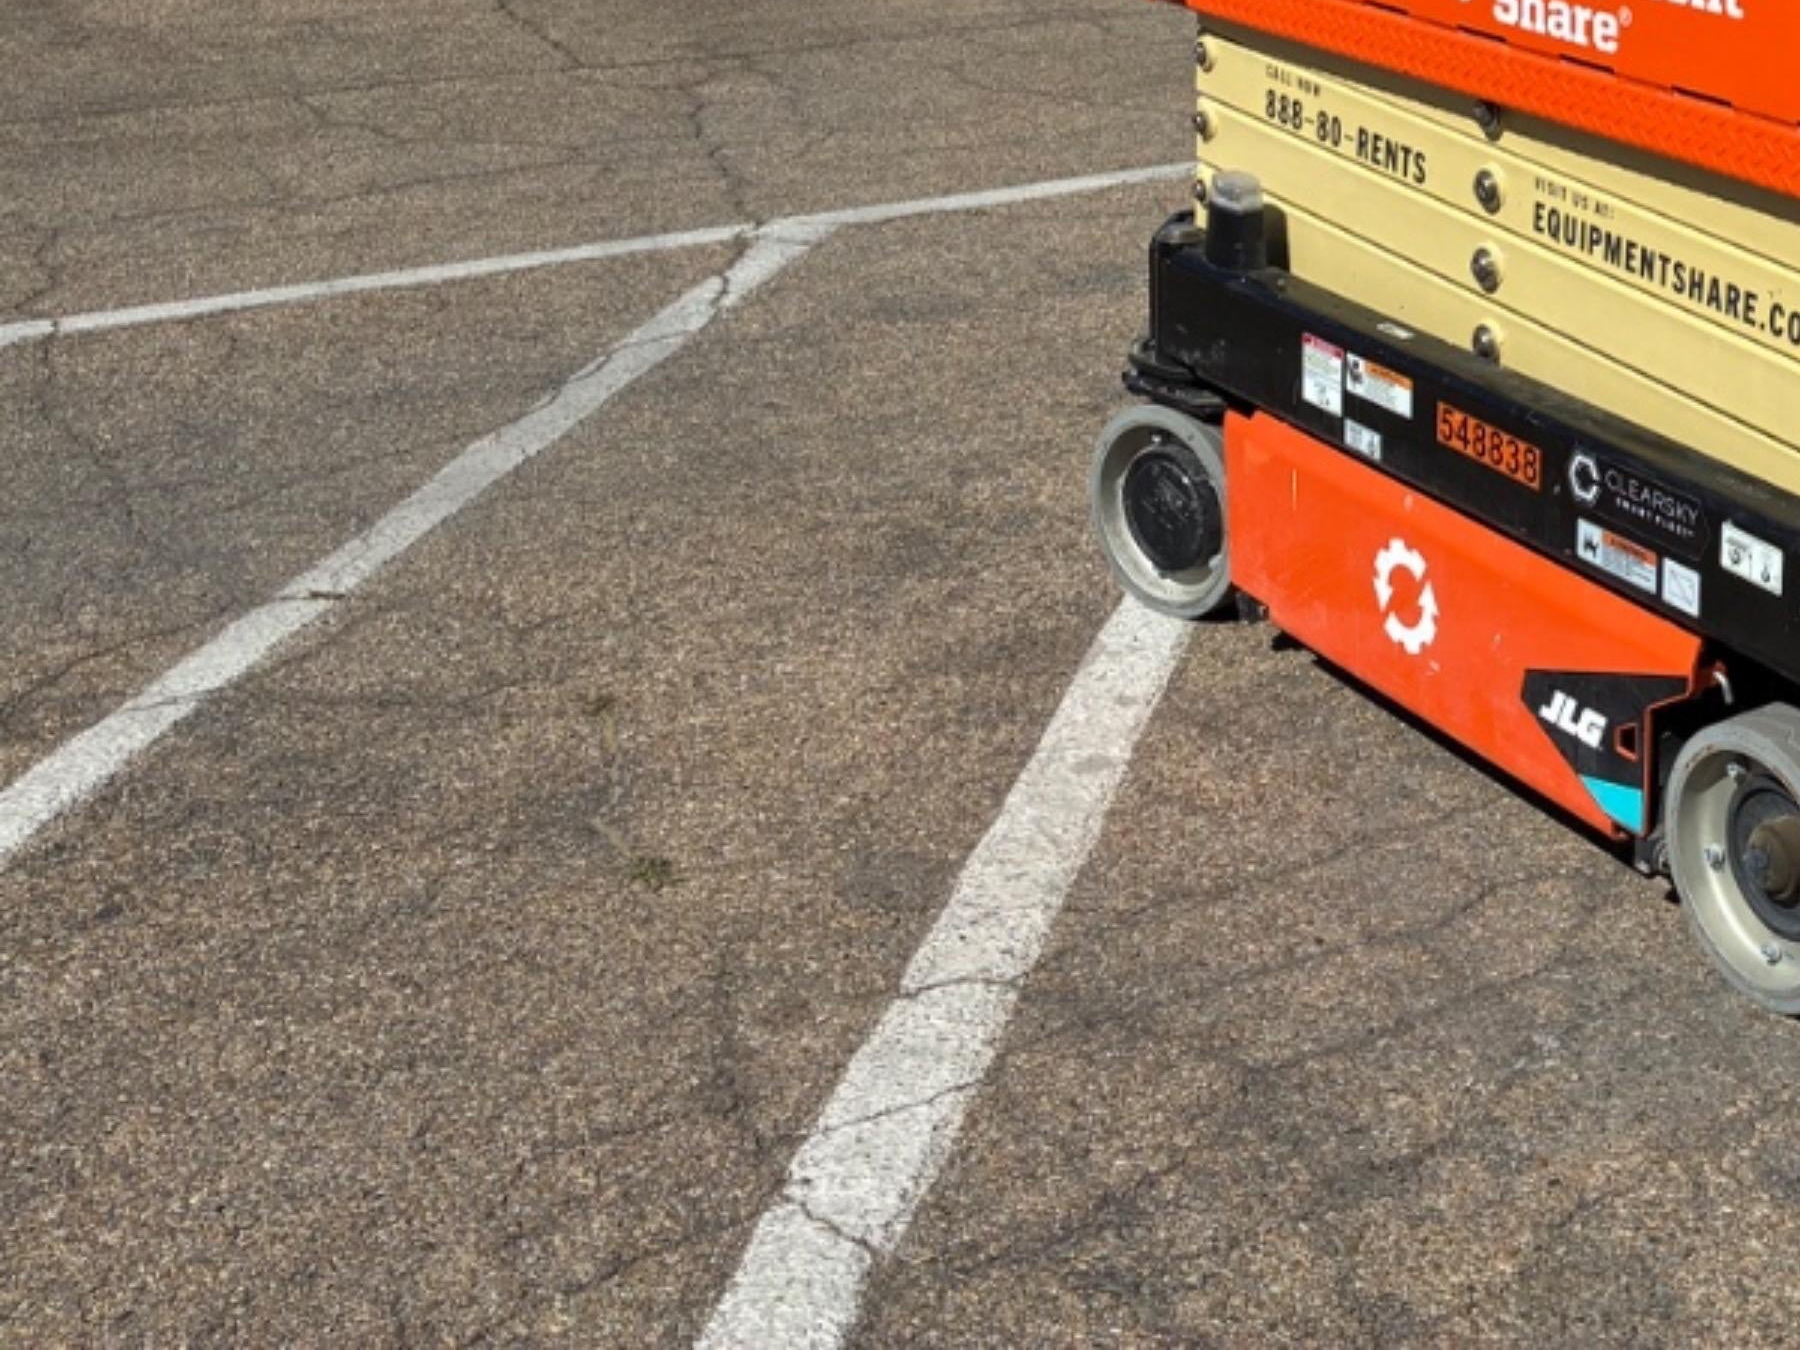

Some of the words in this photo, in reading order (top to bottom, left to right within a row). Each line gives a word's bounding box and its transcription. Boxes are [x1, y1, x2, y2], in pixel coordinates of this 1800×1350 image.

[1265, 88, 1427, 185] 888-80-RENTS
[1439, 407, 1537, 484] 548838
[1604, 469, 1699, 526] CLEARSKY
[1538, 689, 1609, 749] JLG
